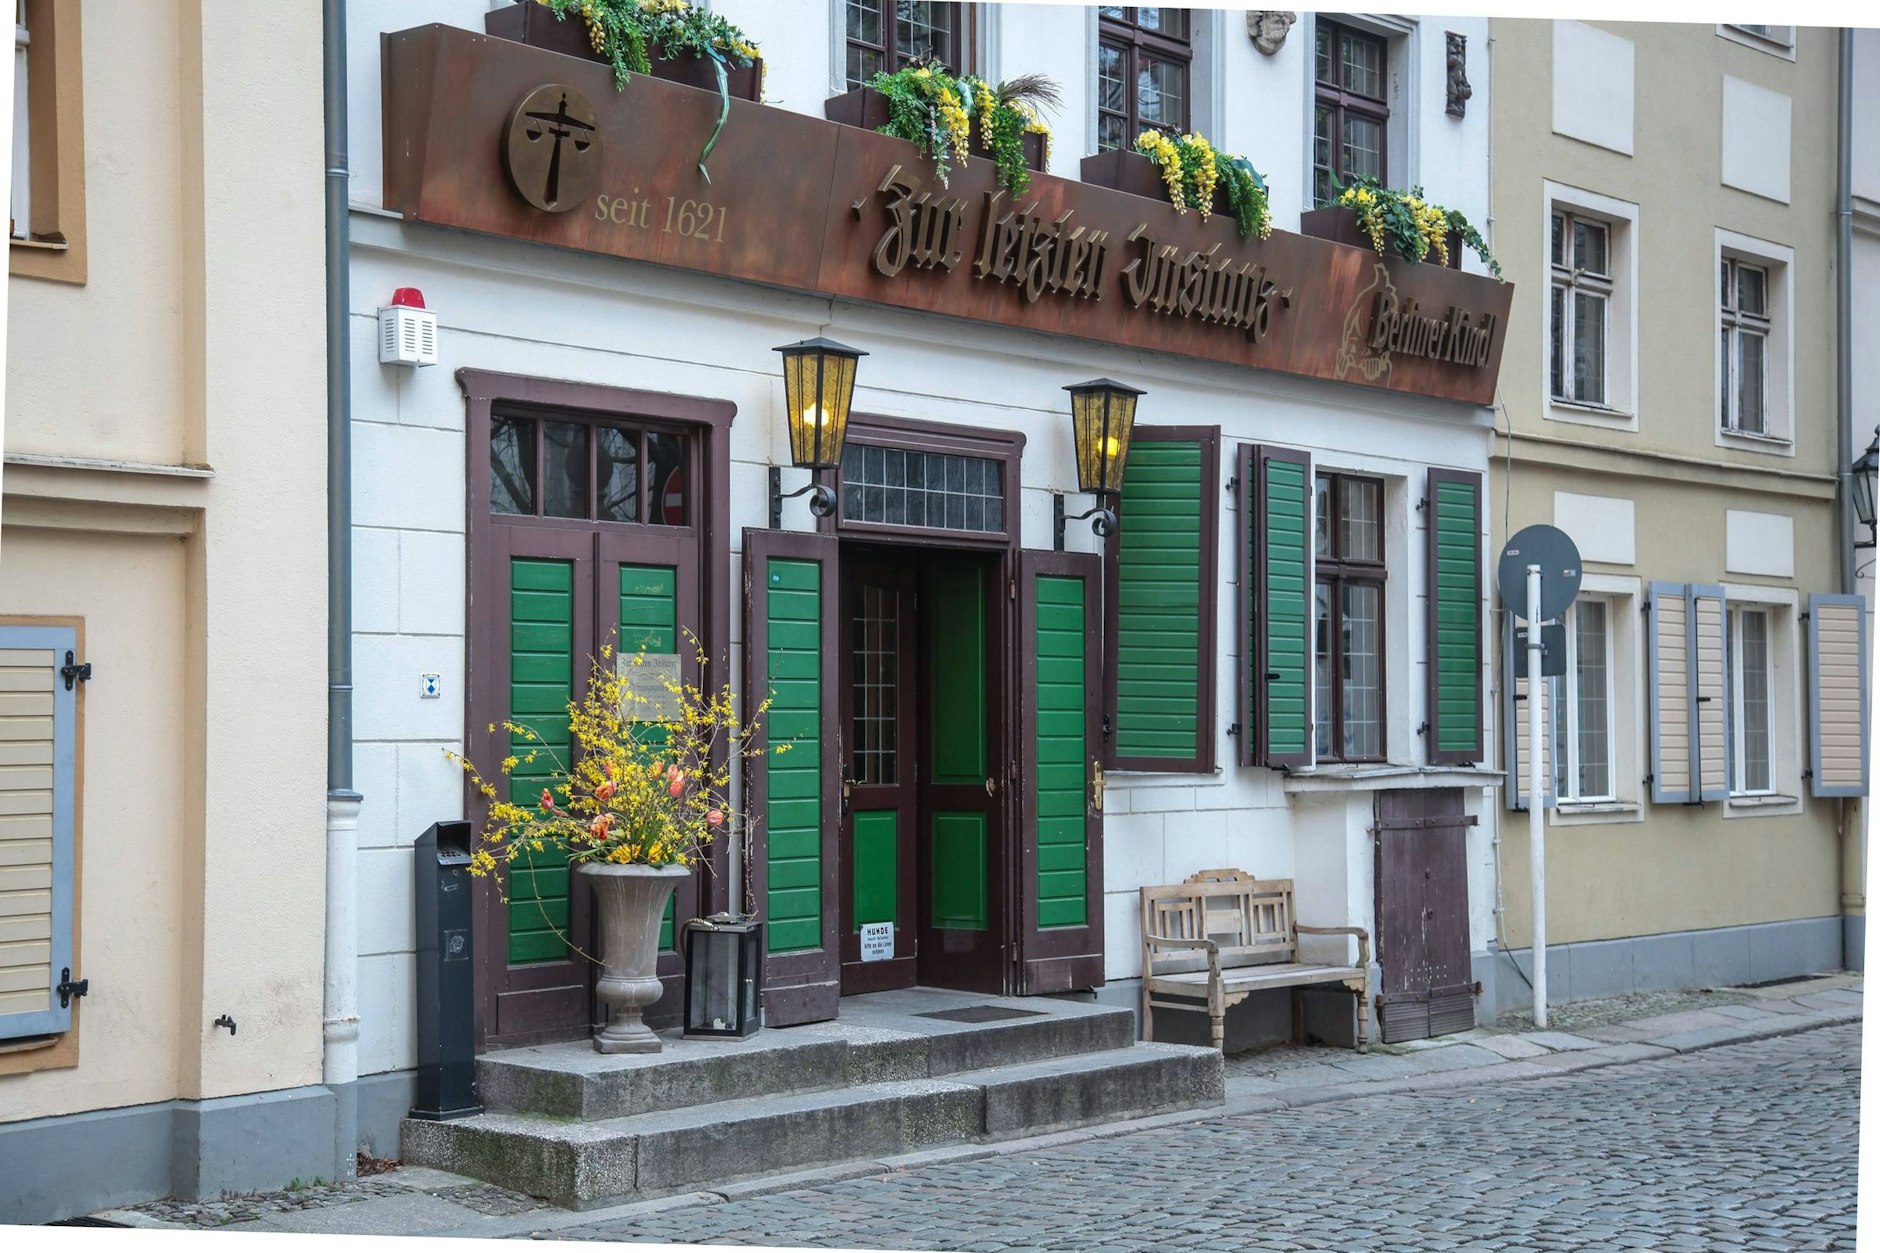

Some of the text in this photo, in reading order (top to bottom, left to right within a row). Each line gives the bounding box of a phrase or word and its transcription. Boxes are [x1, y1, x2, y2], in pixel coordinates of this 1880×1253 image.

[594, 187, 727, 243] seit 1621
[872, 164, 1279, 344] Zur letzten Instanz
[1368, 291, 1497, 368] Berliner Kindl
